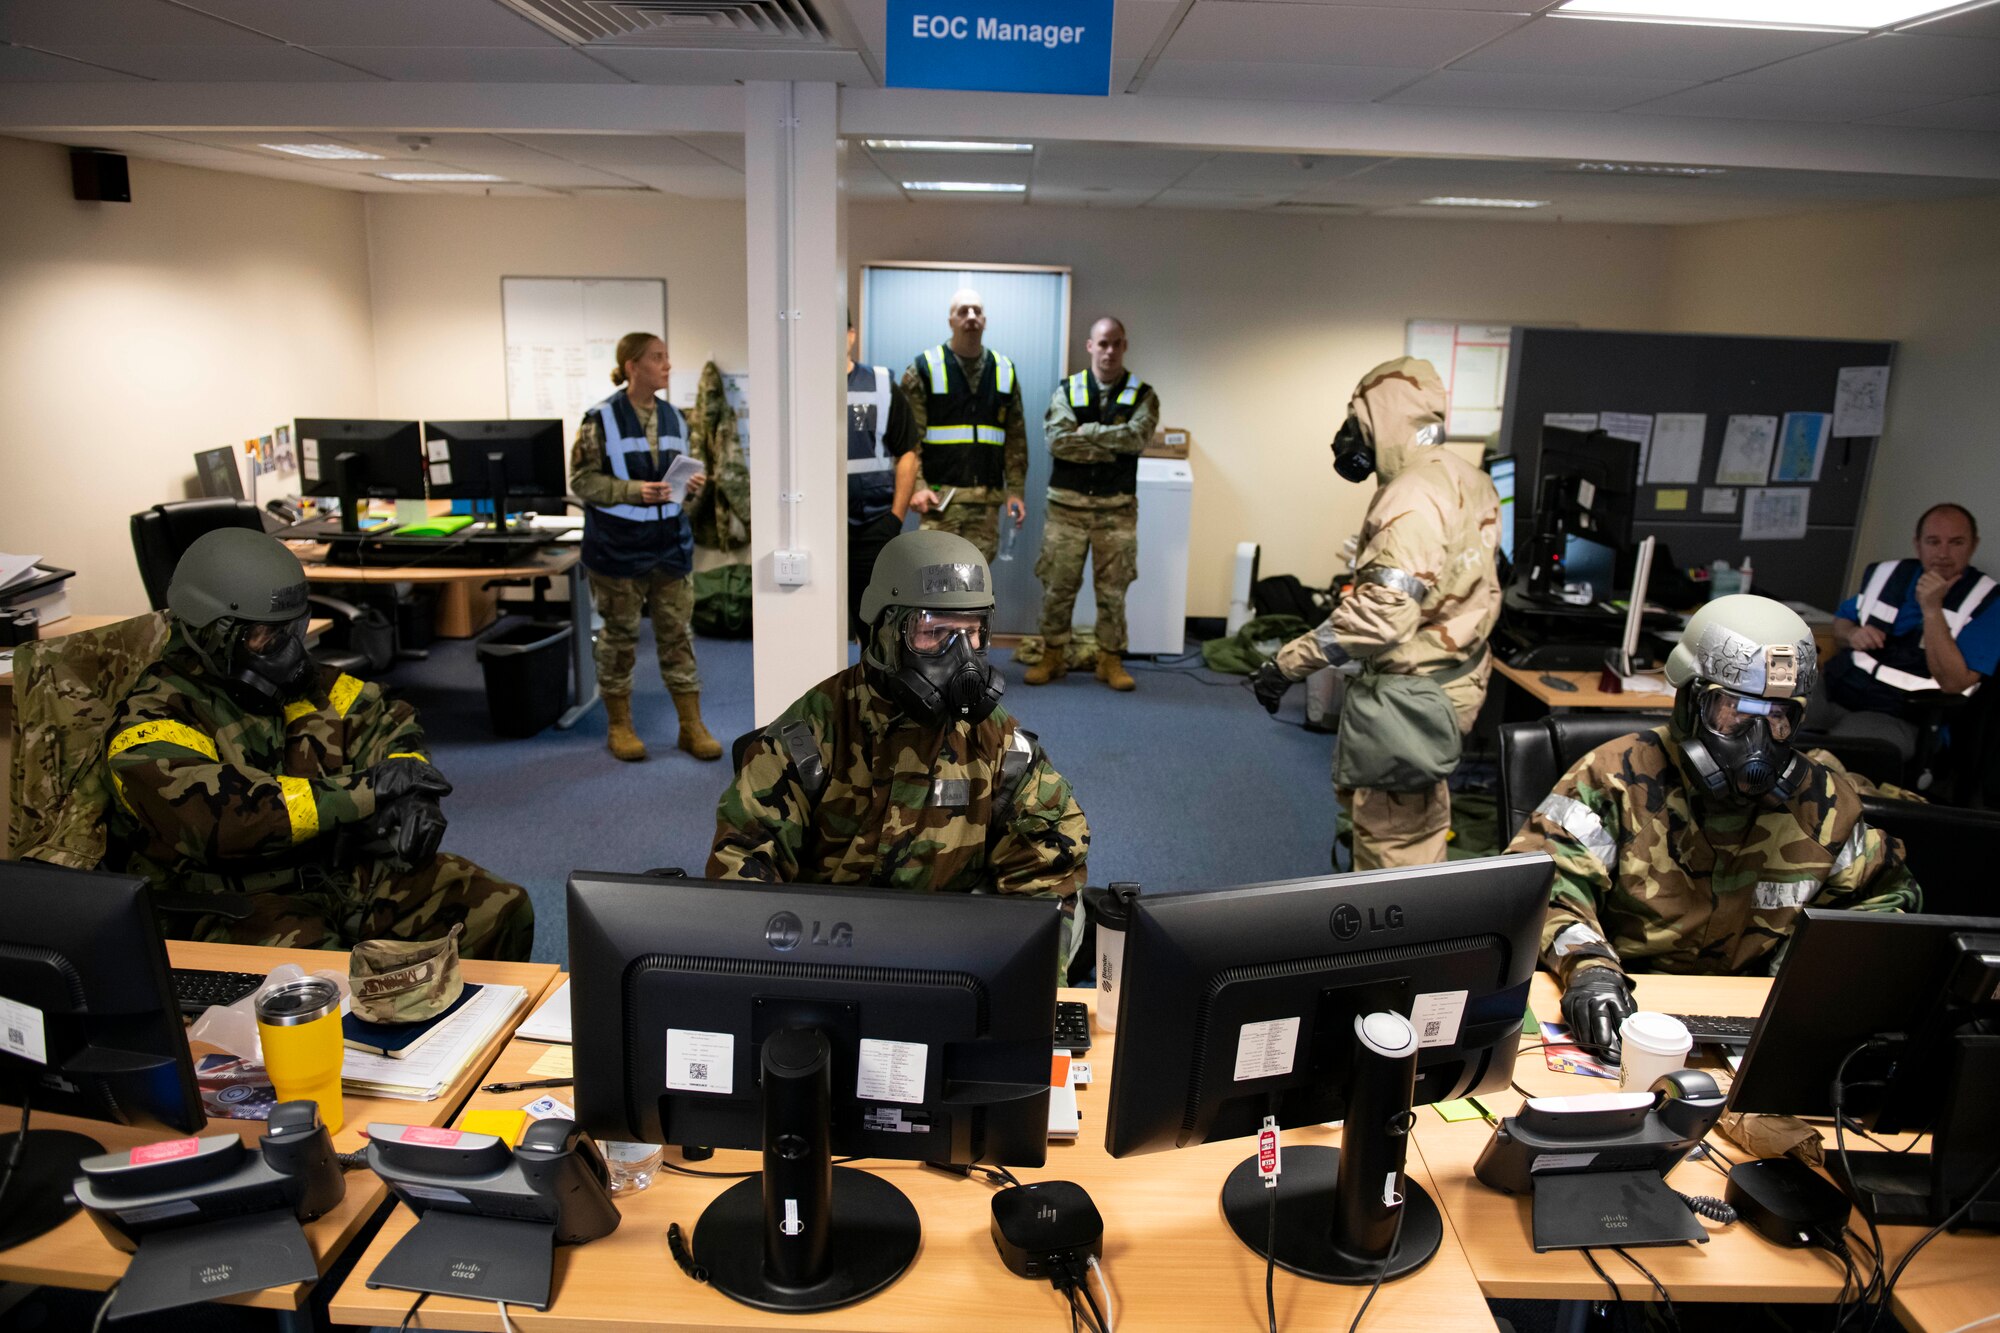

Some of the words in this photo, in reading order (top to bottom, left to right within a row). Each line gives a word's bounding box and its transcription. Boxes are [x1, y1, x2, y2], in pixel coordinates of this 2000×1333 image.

[912, 15, 968, 39] EOC
[976, 17, 1085, 49] Manager
[1368, 904, 1404, 932] LG
[812, 921, 853, 947] LG
[1605, 1221, 1628, 1229] cisco
[202, 1272, 229, 1283] cisco
[451, 1270, 475, 1279] cisco
